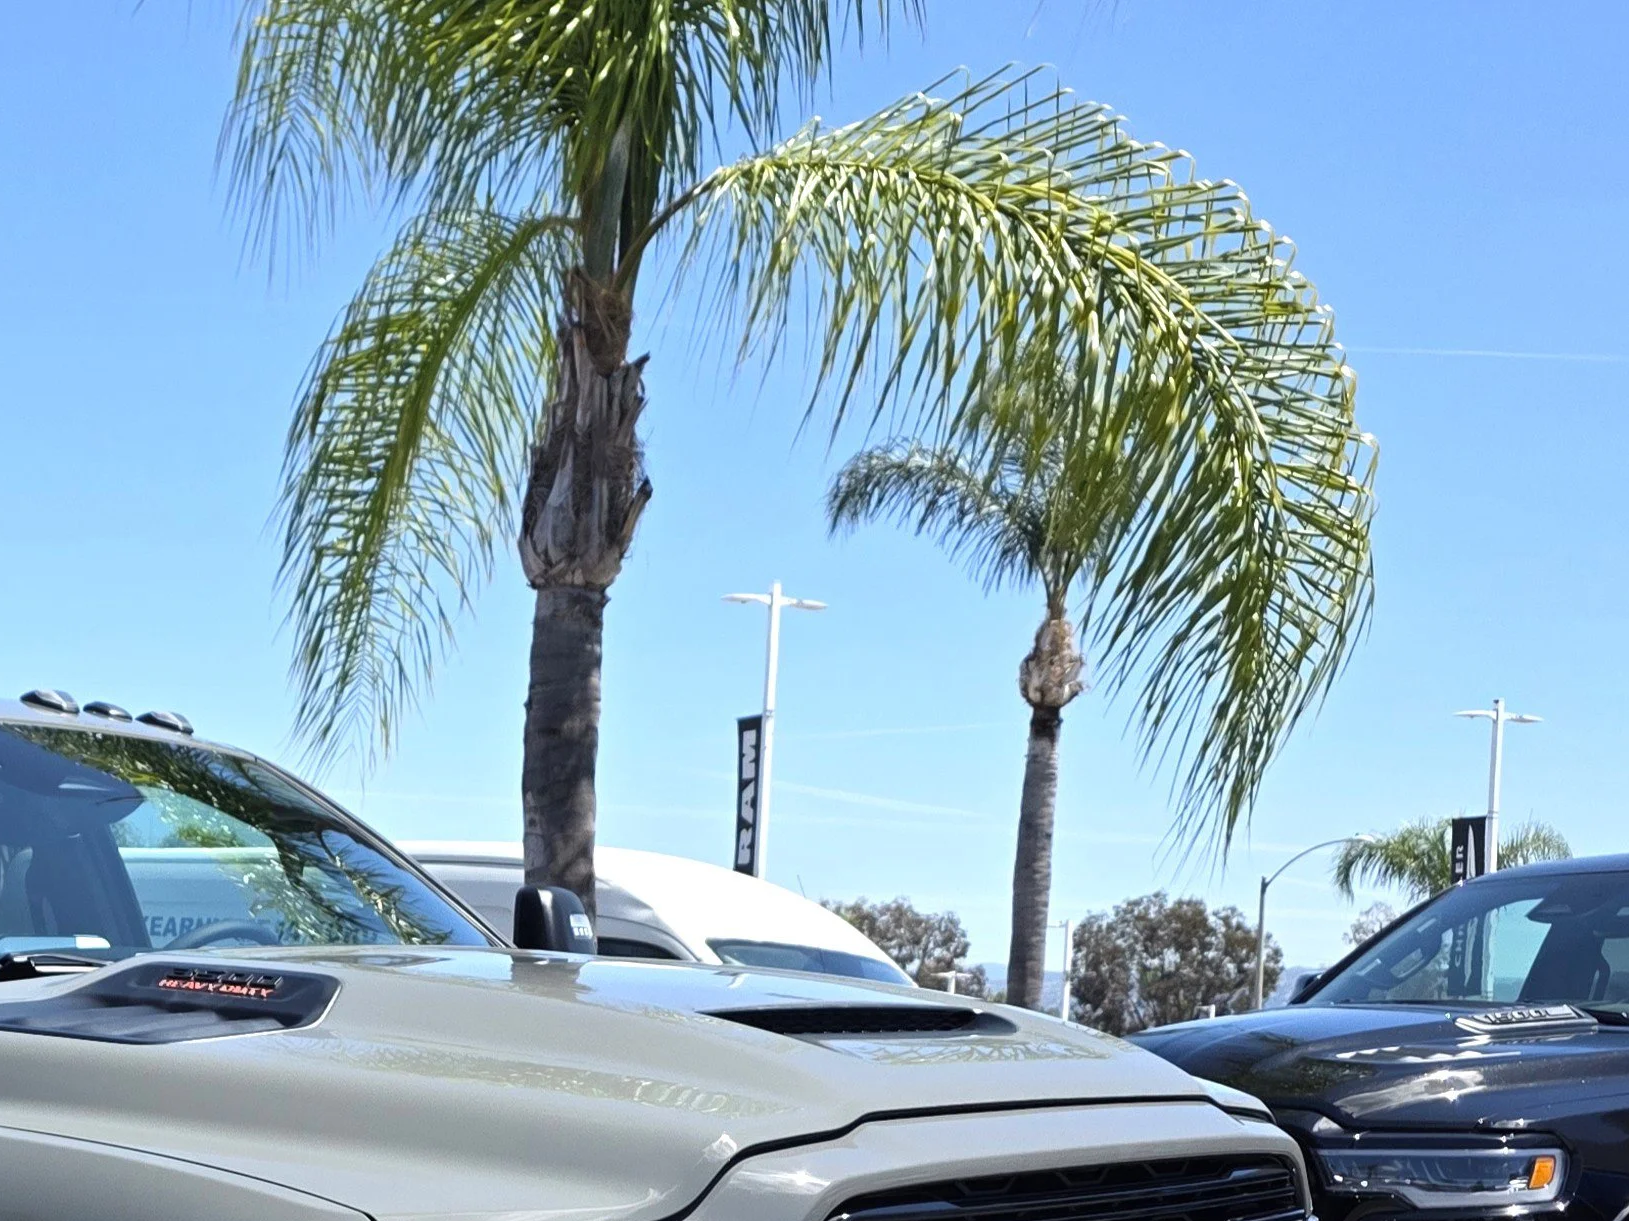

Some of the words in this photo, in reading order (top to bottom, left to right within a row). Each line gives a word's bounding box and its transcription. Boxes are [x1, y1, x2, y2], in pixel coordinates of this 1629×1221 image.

[737, 729, 757, 865] RAM
[158, 979, 220, 991] HEAVY
[219, 983, 275, 998] DUTY
[1484, 1010, 1549, 1023] 1500
